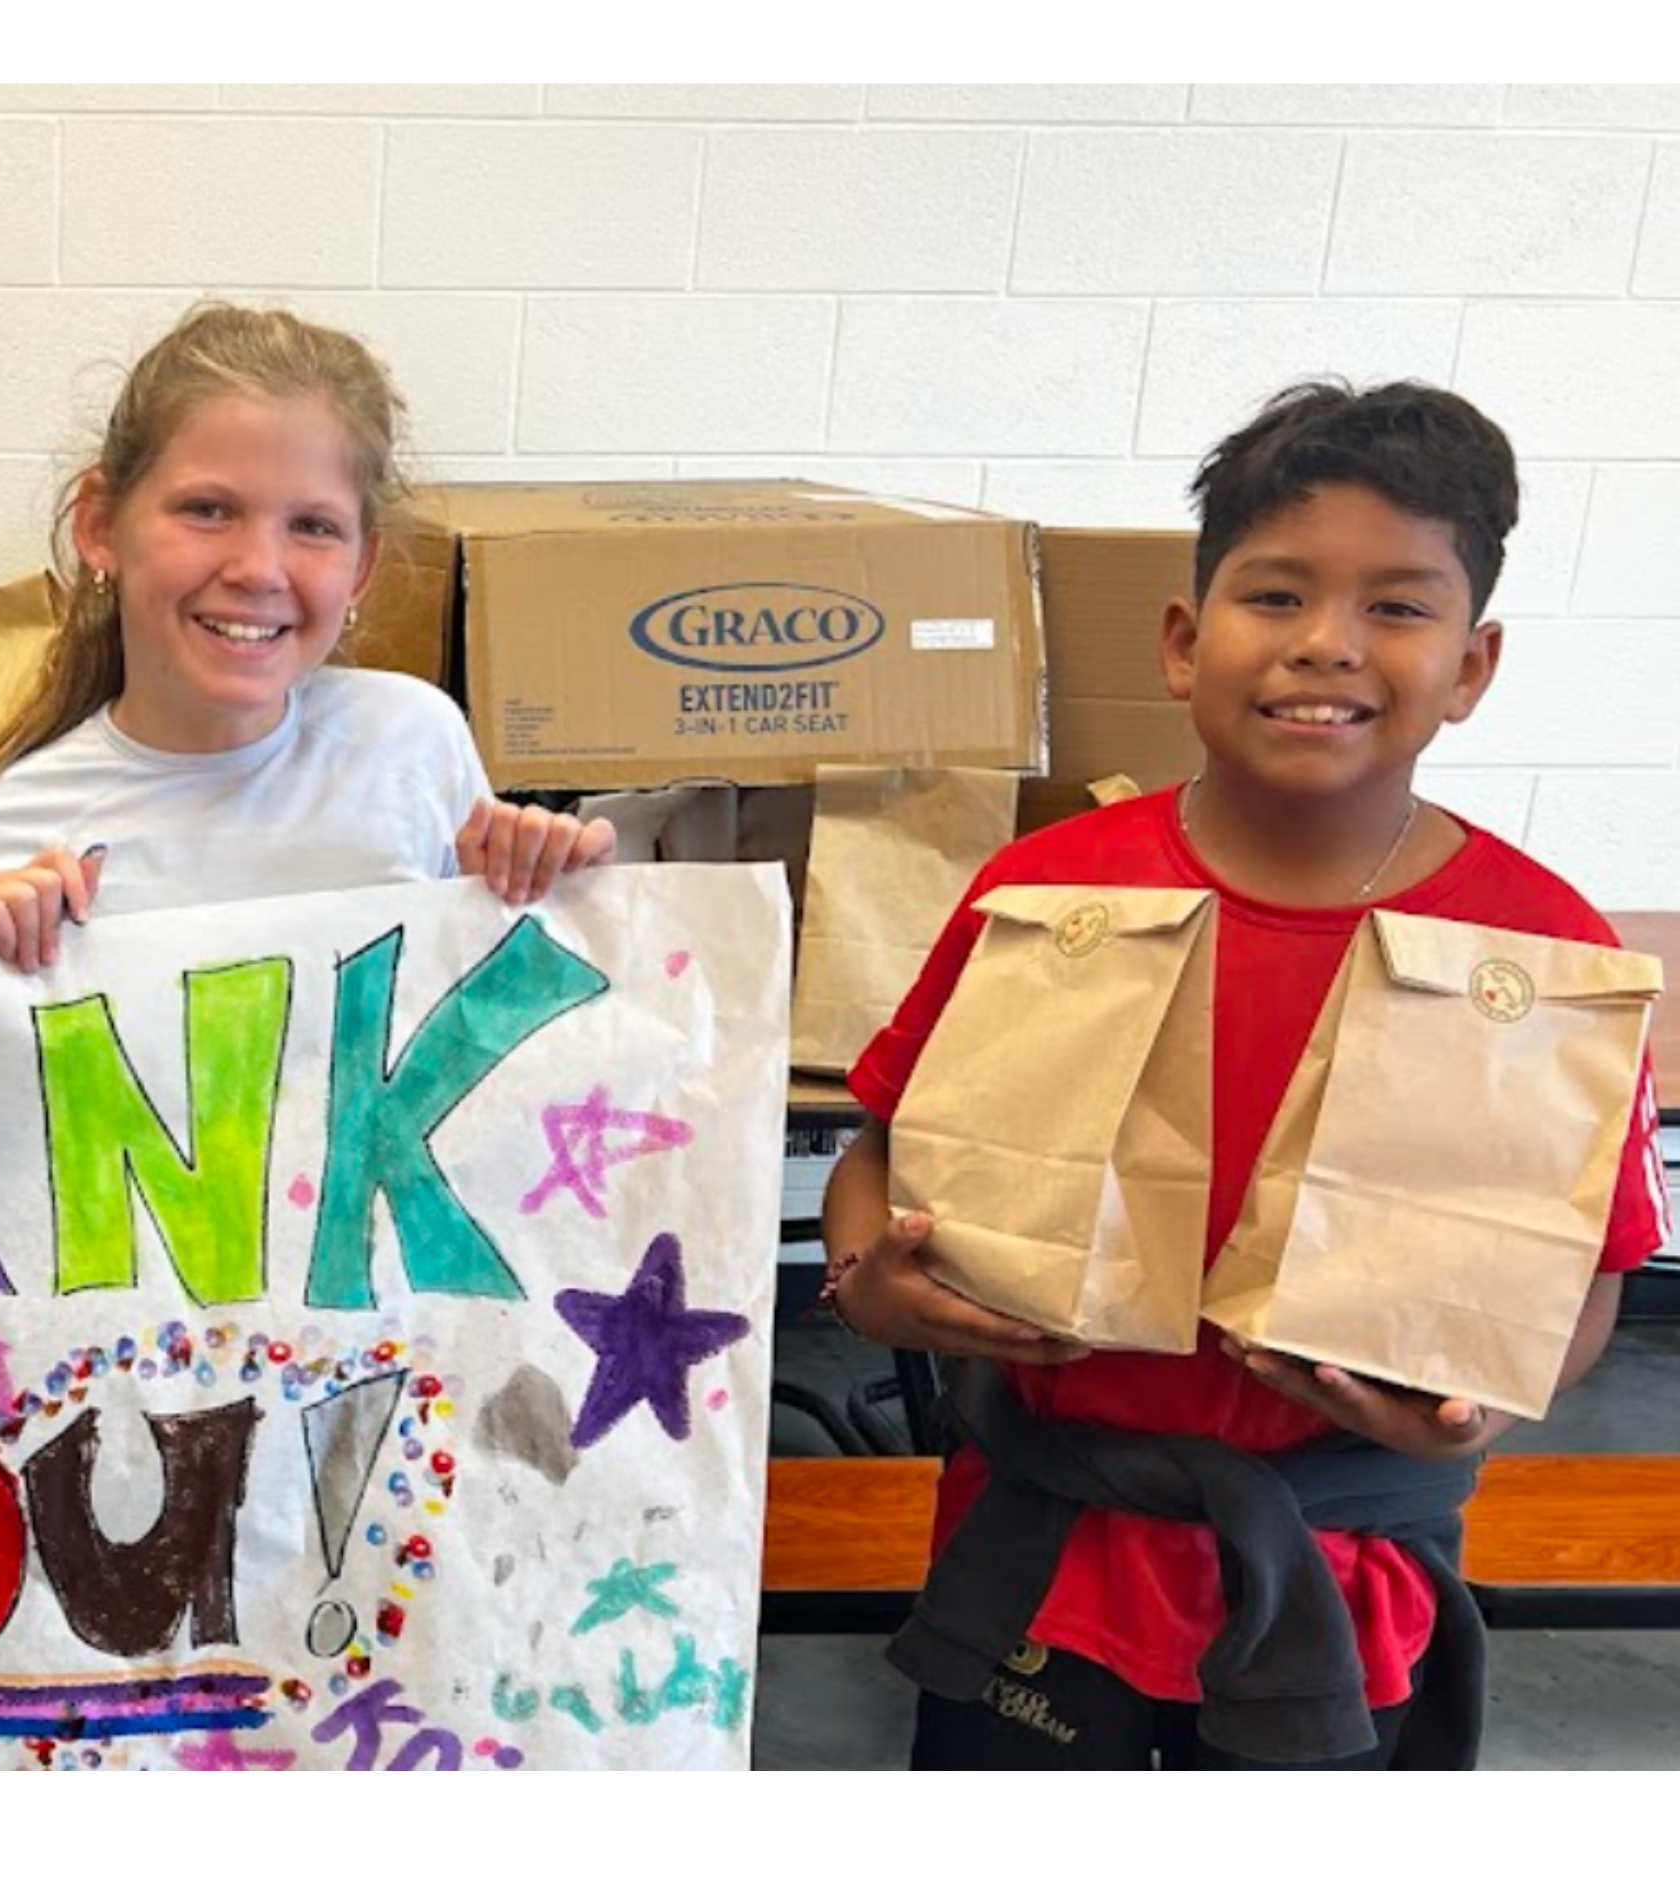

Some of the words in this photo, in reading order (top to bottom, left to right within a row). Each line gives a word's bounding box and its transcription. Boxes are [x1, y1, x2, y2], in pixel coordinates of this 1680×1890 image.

[668, 604, 860, 646] GRACO
[679, 682, 837, 713] EXTEND2FIT
[674, 716, 736, 736] 3-IN-1
[744, 715, 789, 735] CAR
[794, 713, 849, 733] SEAT
